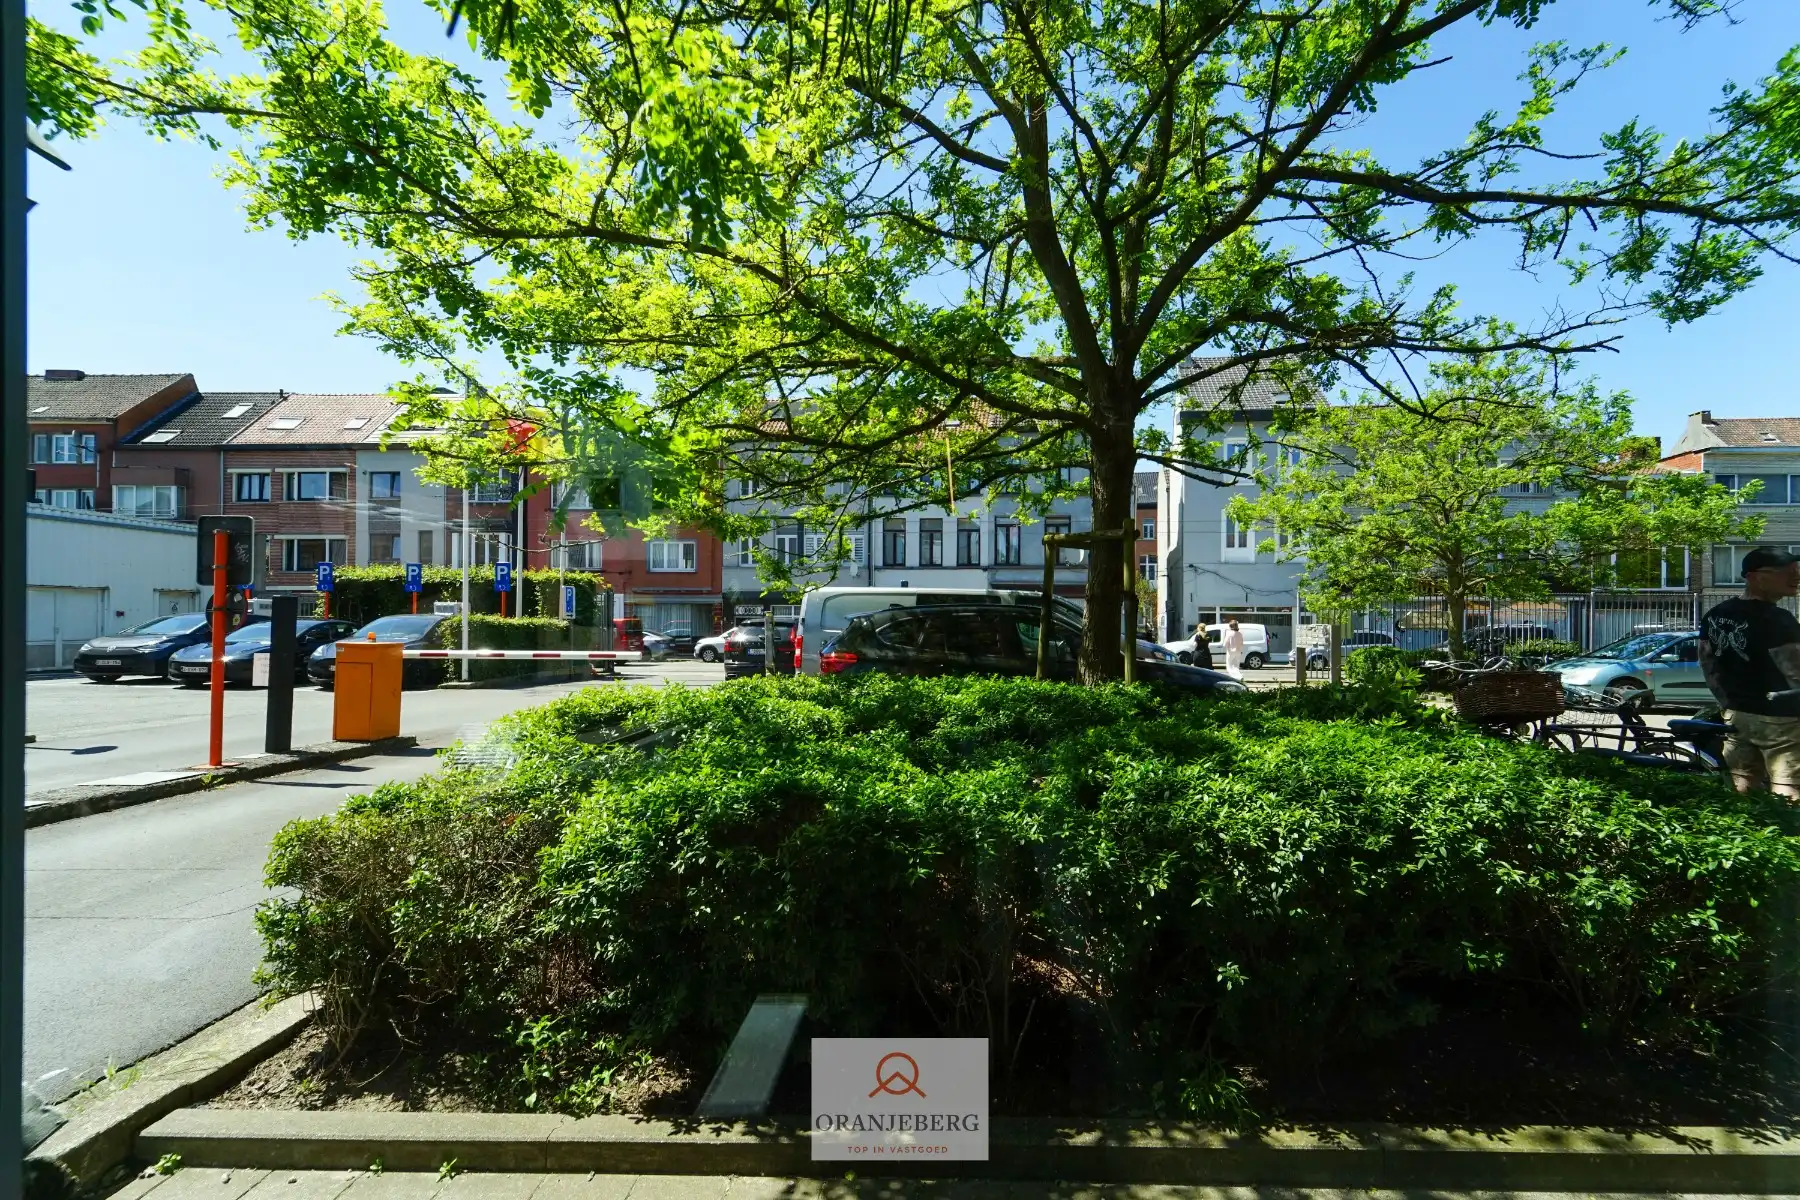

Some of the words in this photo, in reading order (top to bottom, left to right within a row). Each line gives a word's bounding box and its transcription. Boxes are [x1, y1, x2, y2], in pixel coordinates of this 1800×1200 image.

[319, 565, 330, 581] P
[408, 566, 419, 581] P
[496, 565, 508, 581] P
[566, 588, 573, 600] P
